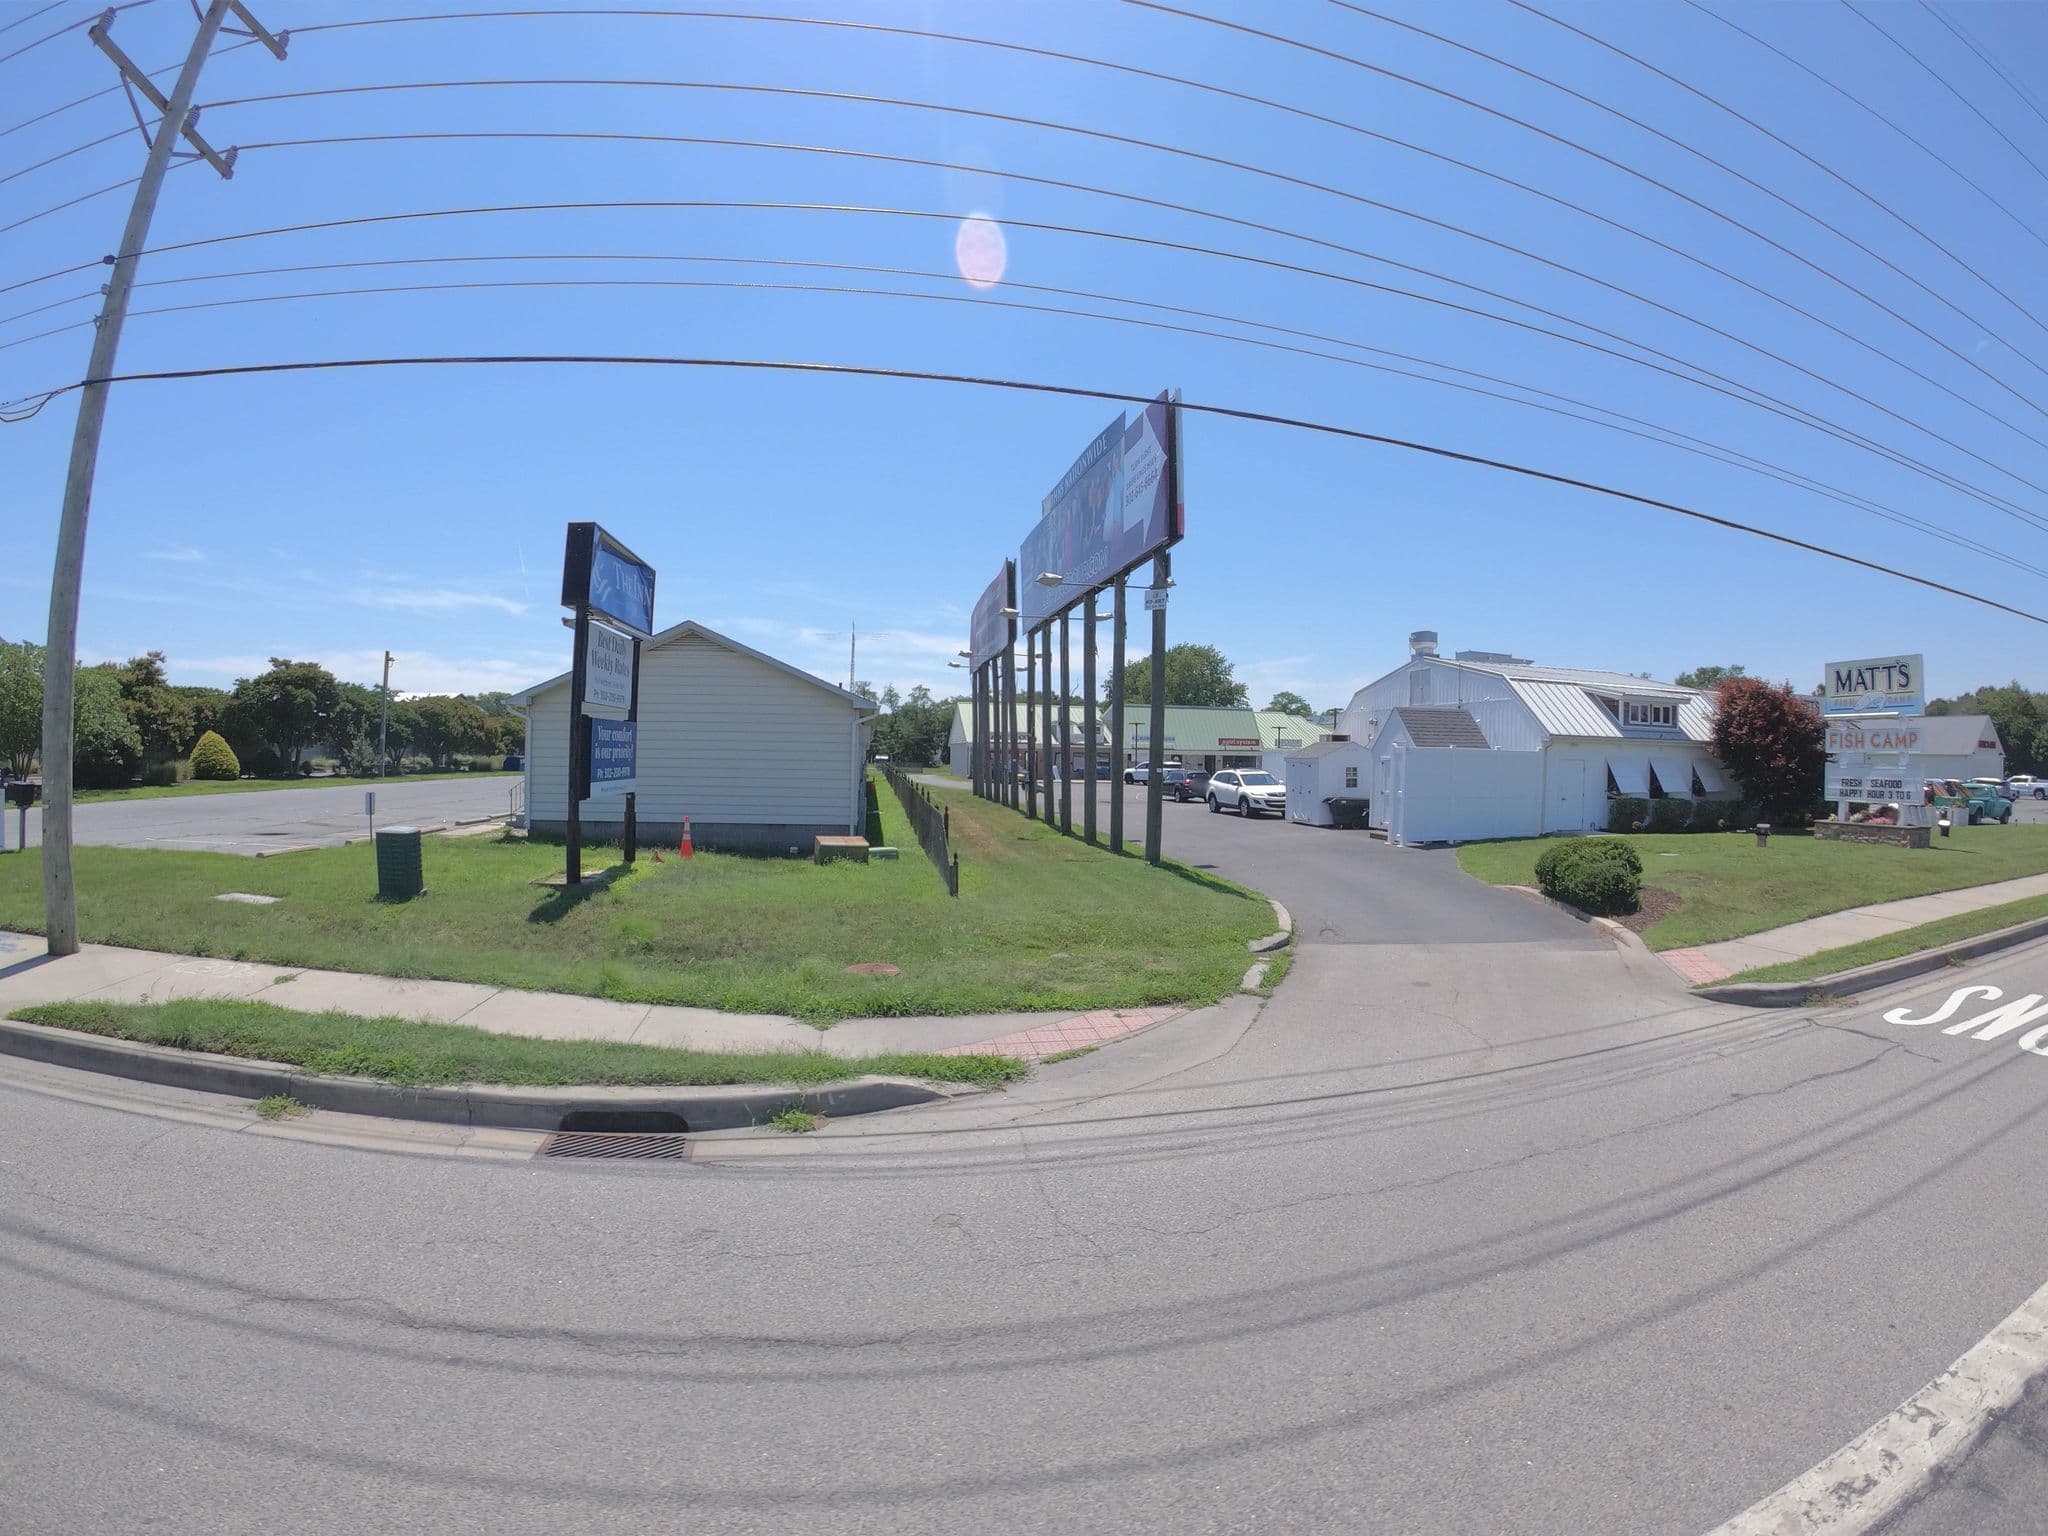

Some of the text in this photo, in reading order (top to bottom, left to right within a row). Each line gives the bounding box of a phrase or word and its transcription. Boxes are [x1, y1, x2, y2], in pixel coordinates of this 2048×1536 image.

[591, 650, 613, 676] Weekly
[1835, 662, 1910, 693] MATT'S
[597, 725, 633, 742] Your comfort
[1829, 731, 1918, 749] FISH CAMP
[601, 747, 612, 760] our
[1841, 778, 1903, 788] FRESH SEAFOOD
[1839, 788, 1863, 798] HAPPY
[1867, 789, 1885, 799] HOUR
[1888, 790, 1893, 799] 3
[1896, 790, 1905, 799] TO
